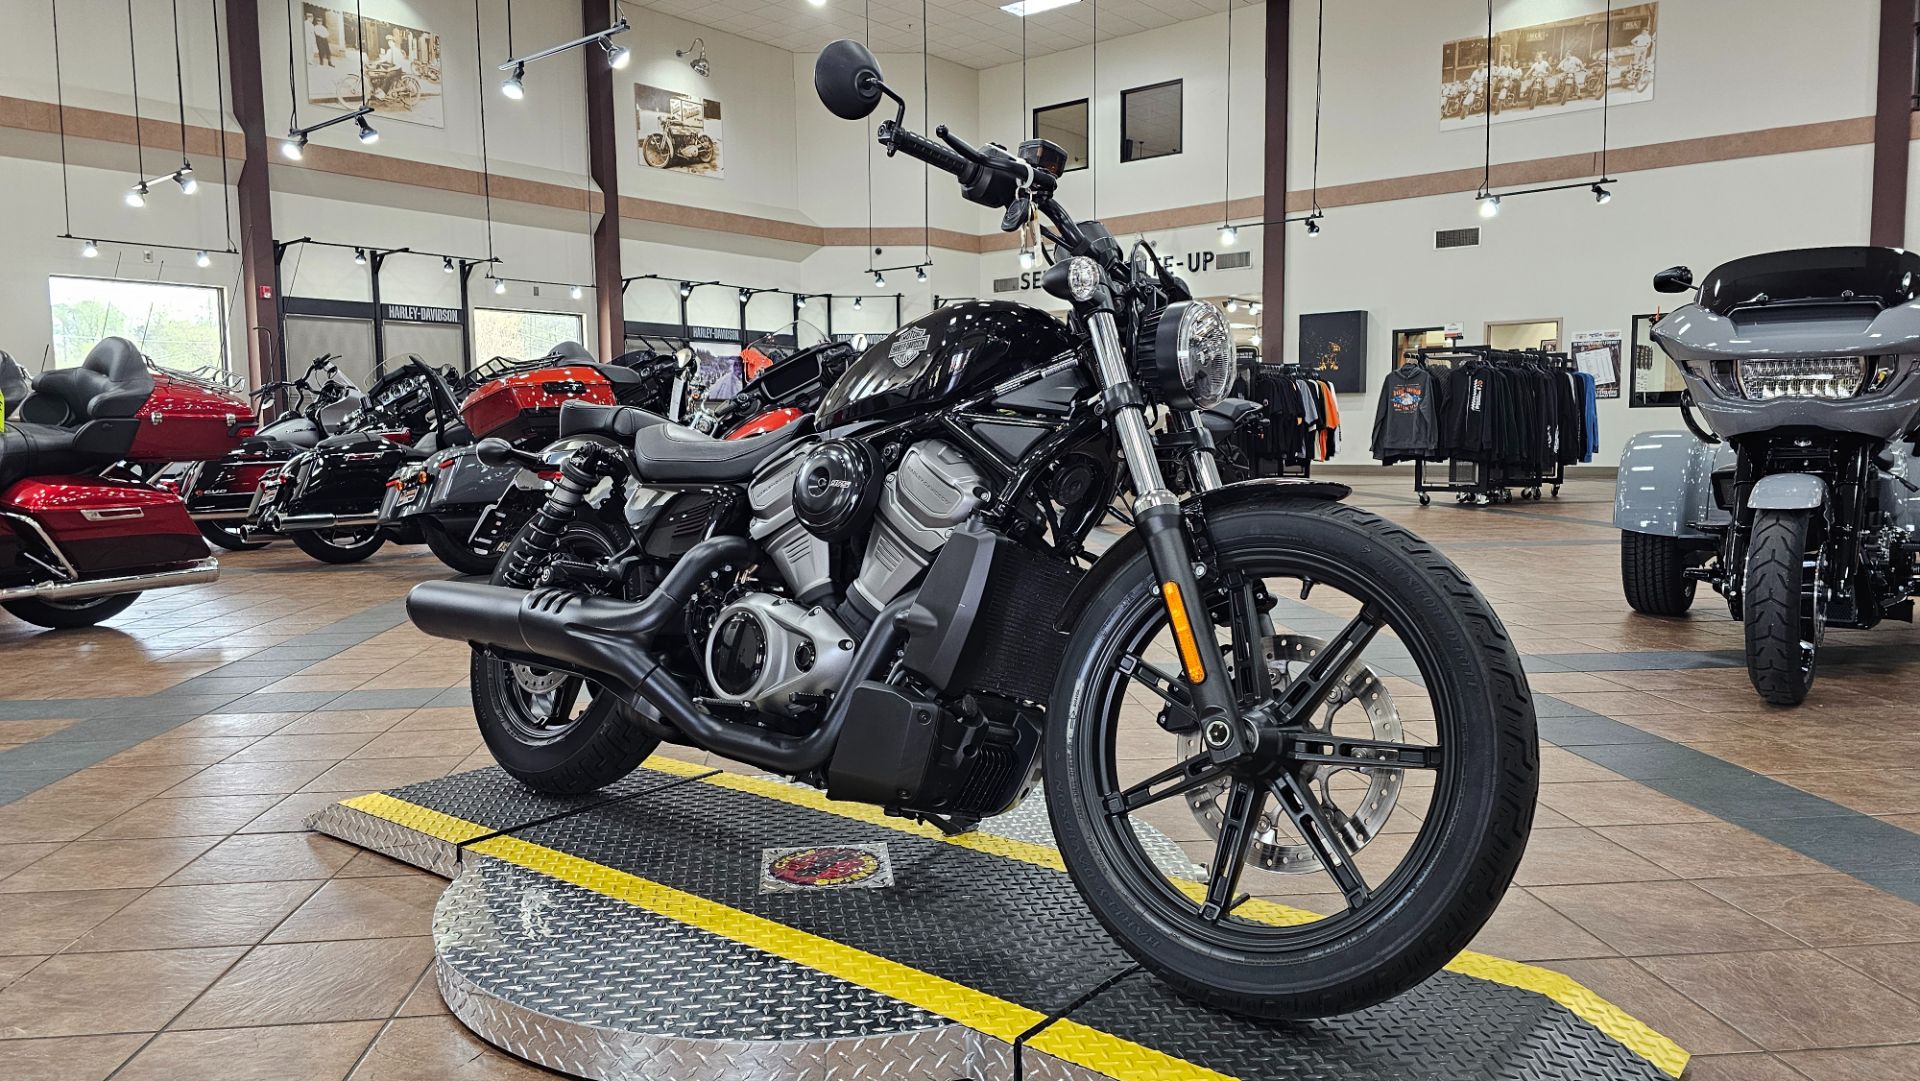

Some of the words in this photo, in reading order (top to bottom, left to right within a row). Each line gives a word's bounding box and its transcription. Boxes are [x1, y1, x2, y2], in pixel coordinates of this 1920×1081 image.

[1020, 271, 1046, 290] SE
[388, 304, 458, 323] HARLEY-DAVIDSON
[692, 326, 739, 341] HARLEY-DAVIDSON
